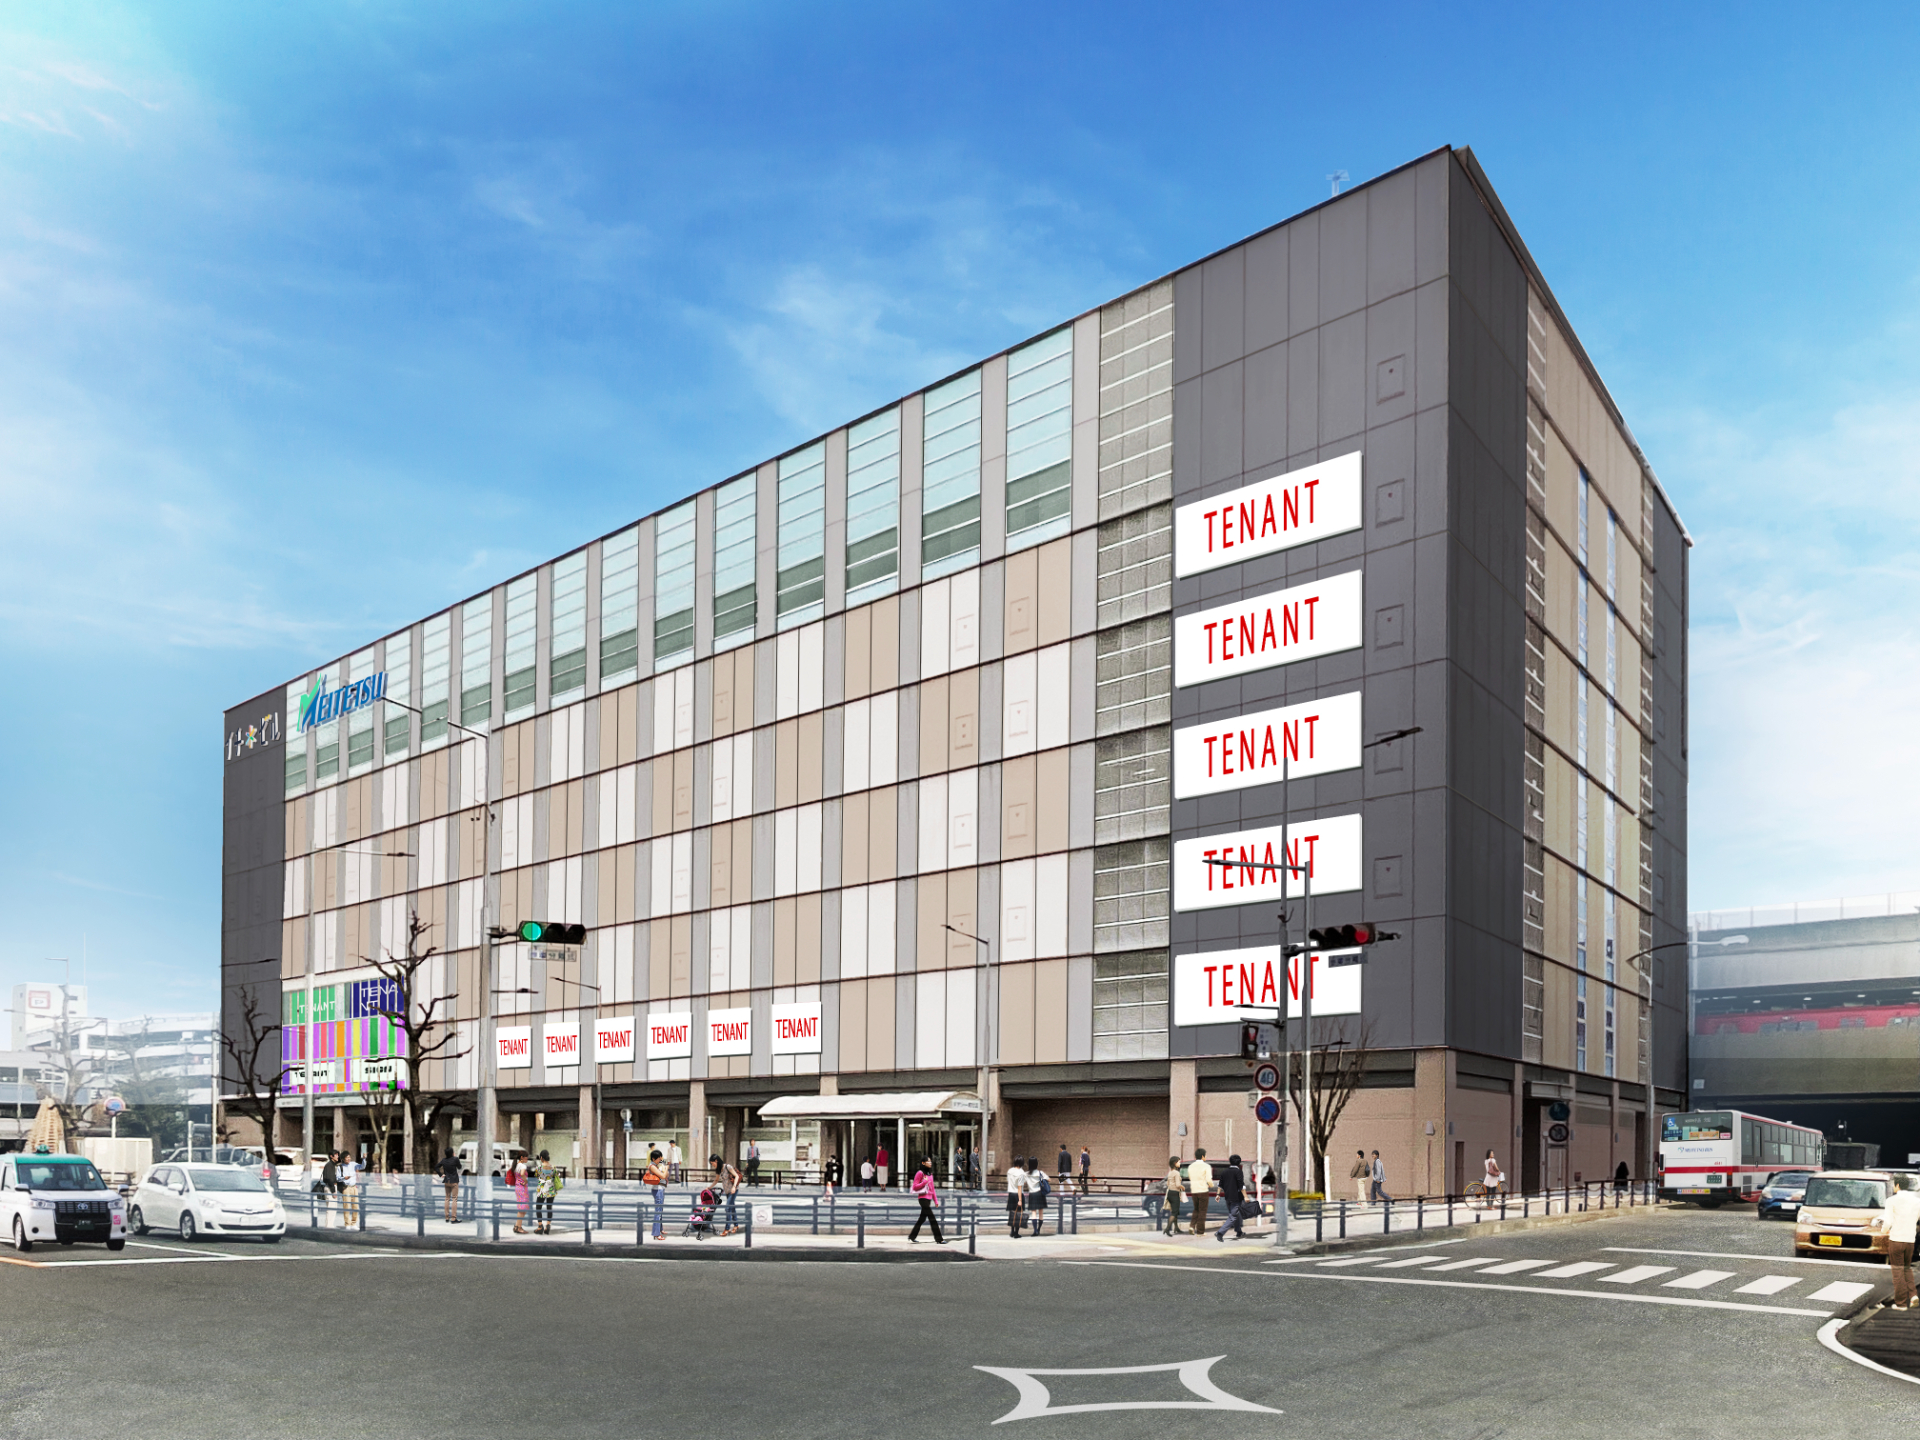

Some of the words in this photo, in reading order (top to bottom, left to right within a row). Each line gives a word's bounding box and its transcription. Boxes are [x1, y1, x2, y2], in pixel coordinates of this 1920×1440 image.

[1204, 478, 1319, 553] TENANT
[1204, 596, 1319, 665] TENANT
[296, 671, 387, 733] MEITETSU
[1204, 715, 1319, 778] TENANT
[1204, 834, 1319, 891] TENANT
[1204, 956, 1319, 1007] TENANT
[299, 1001, 335, 1014] TNANT
[651, 1025, 688, 1045] TENANT
[711, 1021, 748, 1042] TENANT
[775, 1017, 818, 1039] TENANT
[499, 1039, 528, 1056] TENANT
[546, 1035, 577, 1053] TENANT
[598, 1030, 632, 1049] TENANT
[1260, 1071, 1274, 1085] 40
